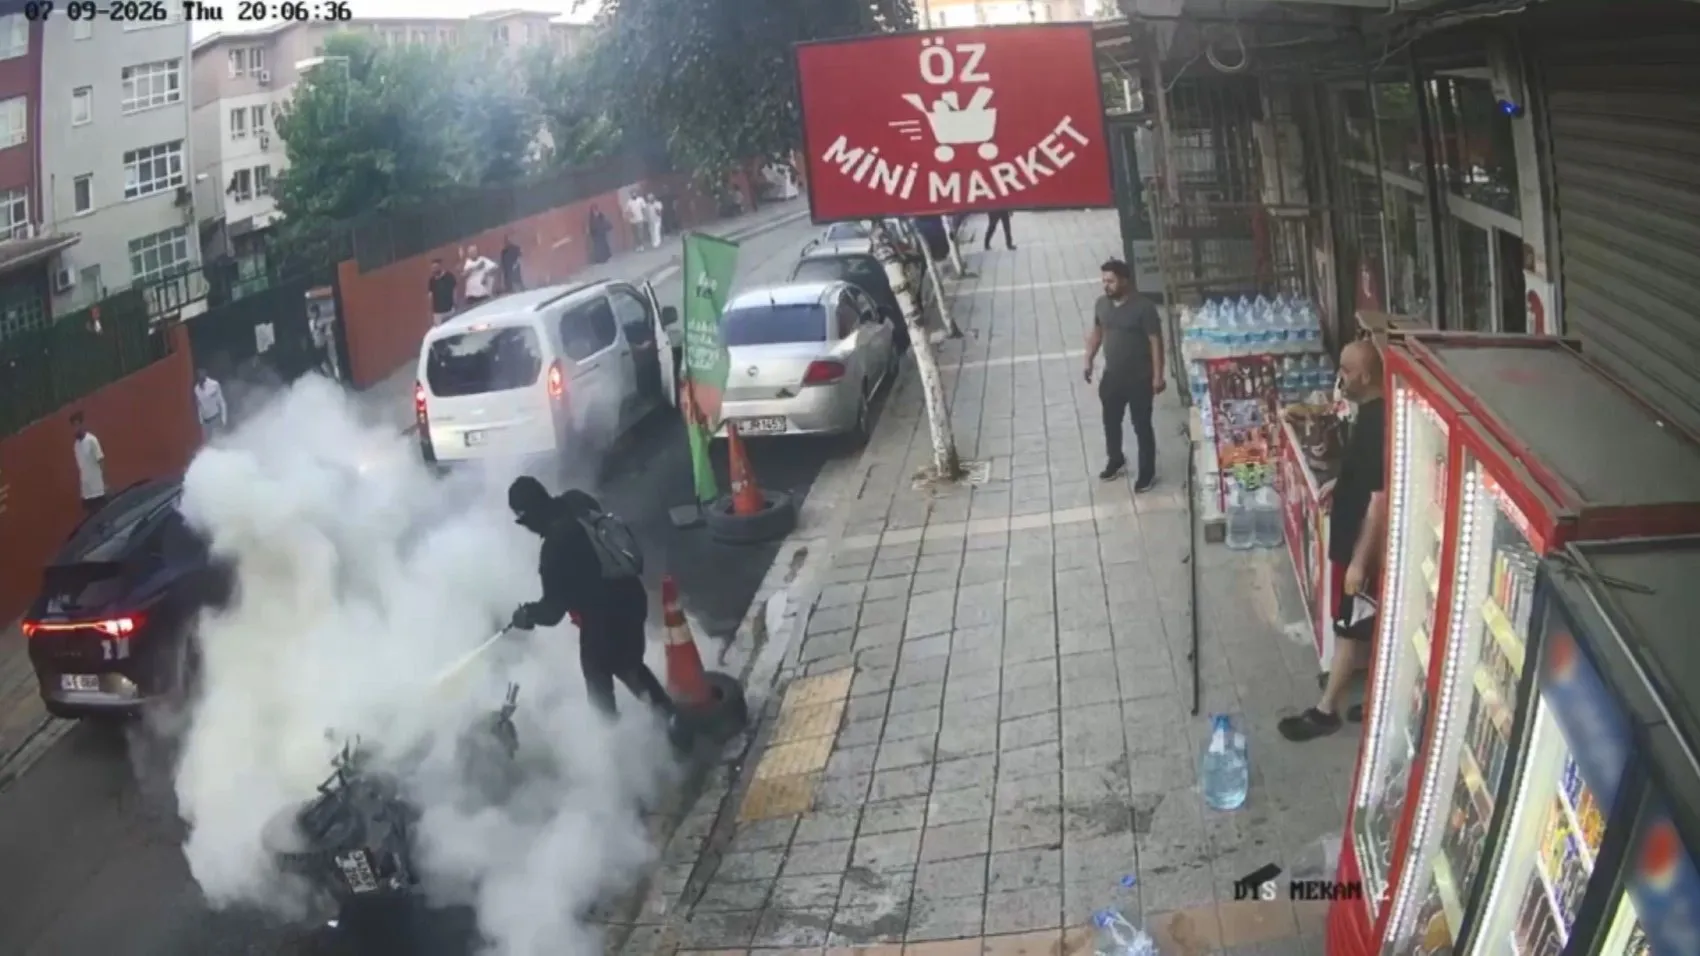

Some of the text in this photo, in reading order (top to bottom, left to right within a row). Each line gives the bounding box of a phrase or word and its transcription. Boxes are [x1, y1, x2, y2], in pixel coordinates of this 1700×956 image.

[919, 36, 990, 85] ÖZ
[821, 115, 1090, 204] MİNİ MARKET
